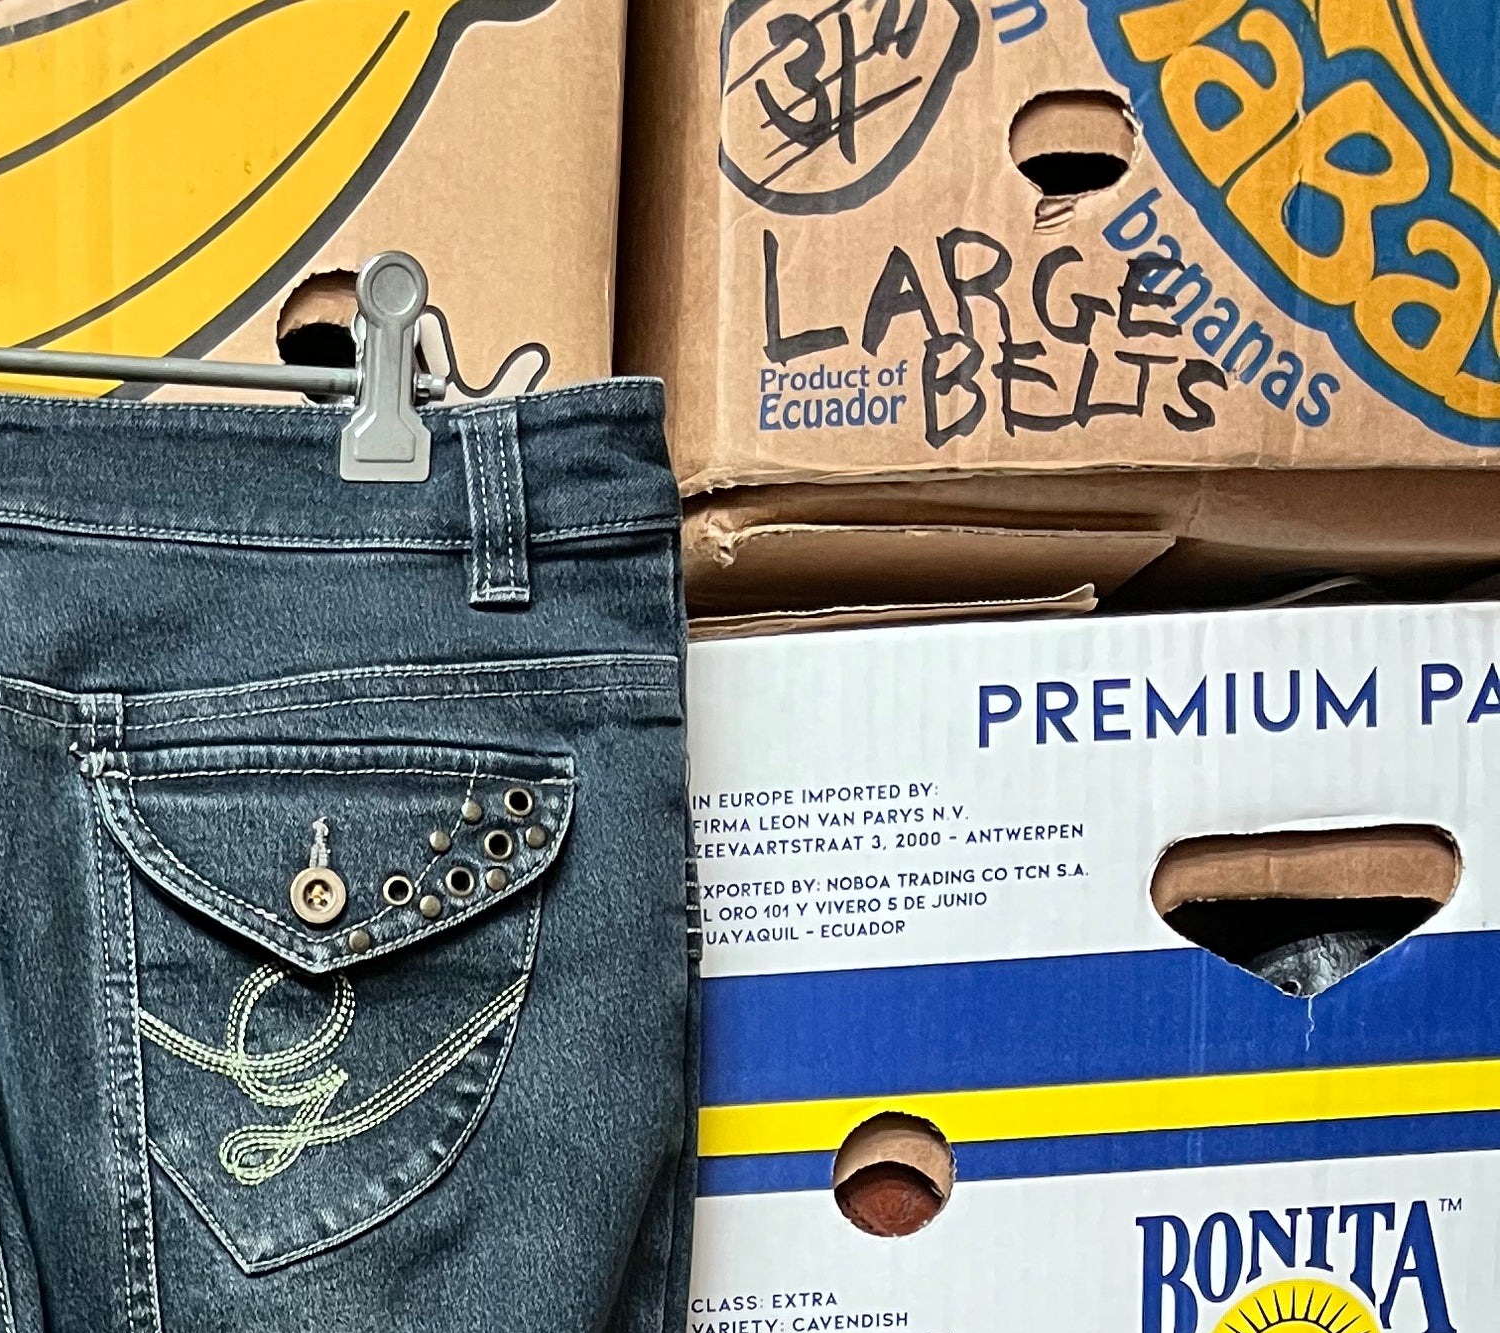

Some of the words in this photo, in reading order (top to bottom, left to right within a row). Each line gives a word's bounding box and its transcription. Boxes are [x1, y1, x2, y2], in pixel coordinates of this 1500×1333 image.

[762, 227, 1185, 366] LARGE
[760, 364, 870, 392] Product
[874, 360, 907, 388] of
[922, 333, 1228, 448] BELTS
[759, 388, 906, 431] Ecuador
[978, 666, 1377, 748] PREMIUM
[719, 790, 794, 809] EUROPE
[802, 784, 901, 804] IMPORTED
[909, 781, 939, 798] BY:
[693, 817, 751, 835] FIRMA
[759, 814, 810, 832] LEON
[818, 811, 855, 828] VAN
[863, 808, 925, 825] PARYS
[694, 835, 864, 859] ZEEVAARTSTRAAT
[896, 830, 941, 848] 2000
[966, 823, 1085, 844] ANTWERPEN
[700, 881, 785, 901] XPORTED
[827, 873, 890, 893] NOBOA
[898, 869, 976, 888] TRADING
[982, 866, 1008, 882] CO
[1015, 864, 1050, 880] TCN
[719, 904, 758, 922] ORO
[763, 903, 790, 919] 101
[816, 898, 881, 916] VIVERO
[904, 895, 926, 911] DE
[932, 892, 988, 909] JUNIO
[703, 926, 800, 947] UAYAQUIL
[821, 920, 906, 940] ECUADOR
[691, 1295, 764, 1314] CLASS:
[772, 1292, 838, 1310] EXTRA
[792, 1312, 909, 1333] CAVENDISH
